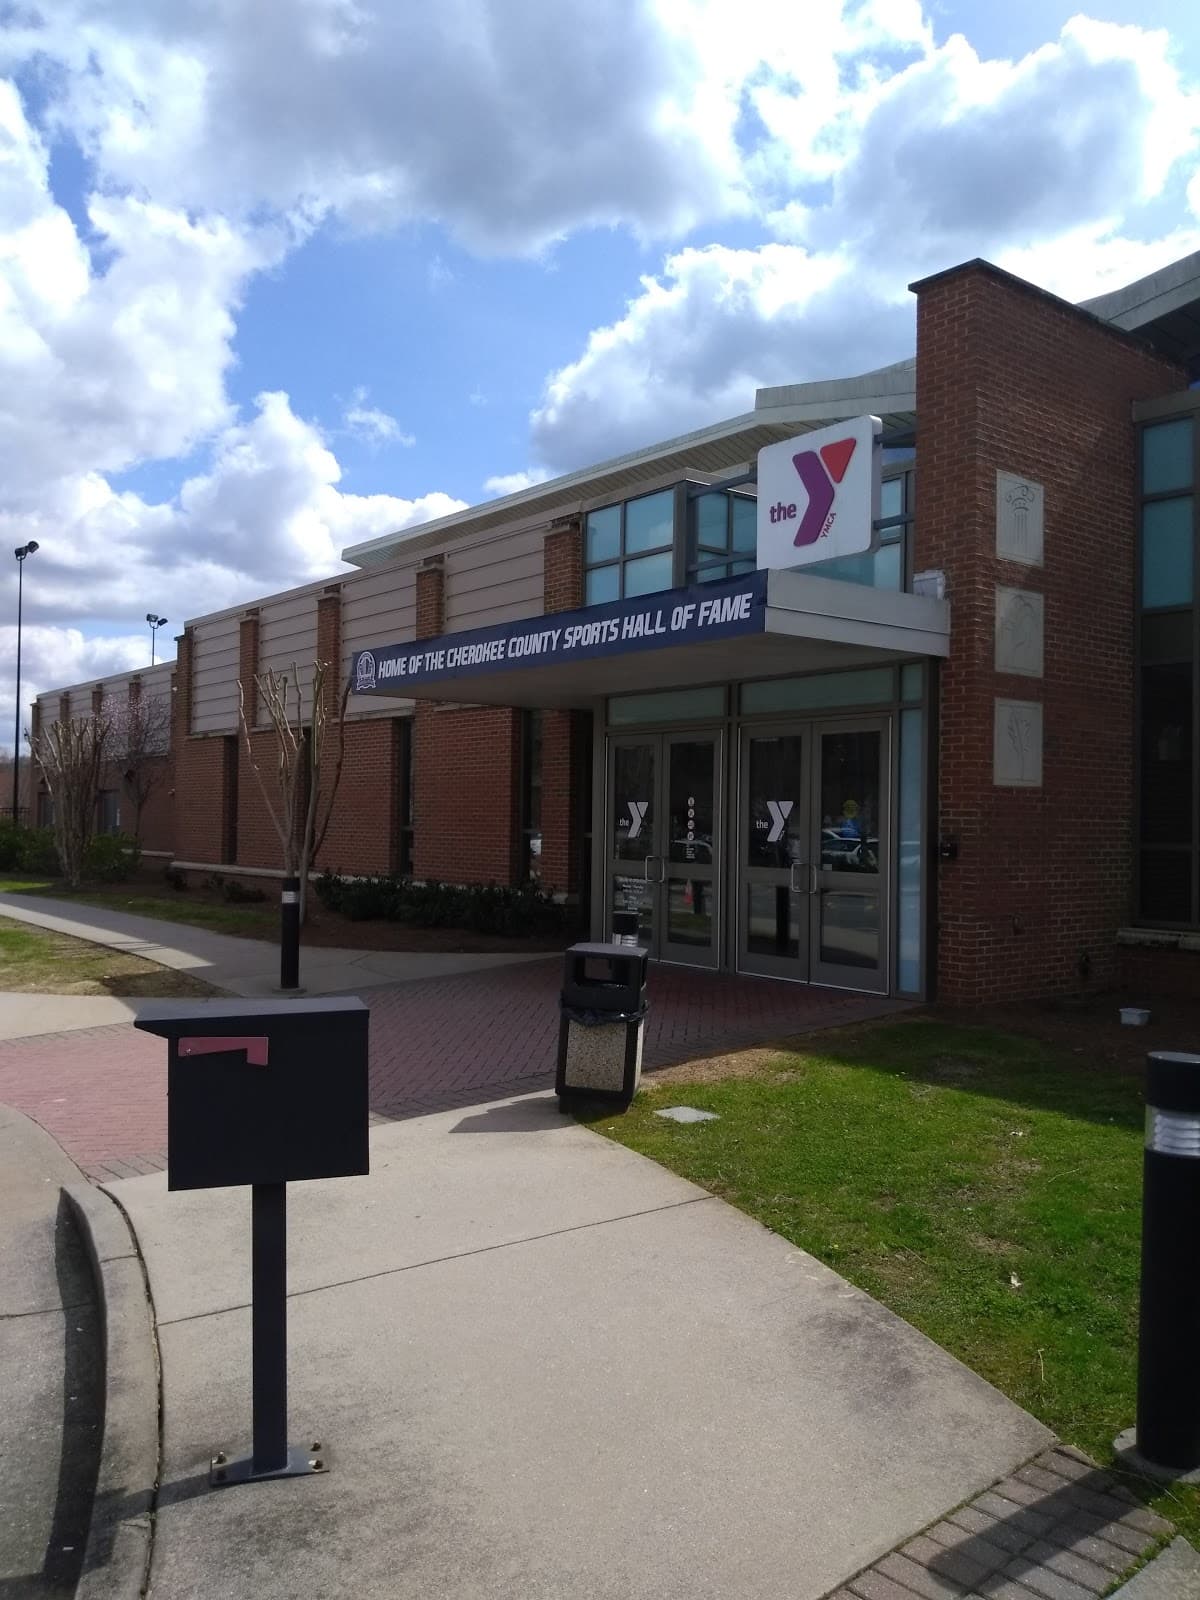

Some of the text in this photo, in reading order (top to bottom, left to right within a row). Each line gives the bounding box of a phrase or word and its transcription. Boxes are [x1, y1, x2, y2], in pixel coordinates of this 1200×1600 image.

[769, 501, 797, 524] the
[820, 511, 837, 538] YMCA
[378, 656, 408, 679] HOME
[408, 654, 424, 674] OF
[424, 650, 446, 672] THE
[446, 639, 506, 668] CHEROKEE
[507, 628, 562, 658] COUNTY
[563, 617, 619, 649] SPORTS
[621, 608, 666, 639] HALL
[670, 603, 695, 631] OF
[697, 592, 754, 627] FAME
[756, 819, 769, 829] the
